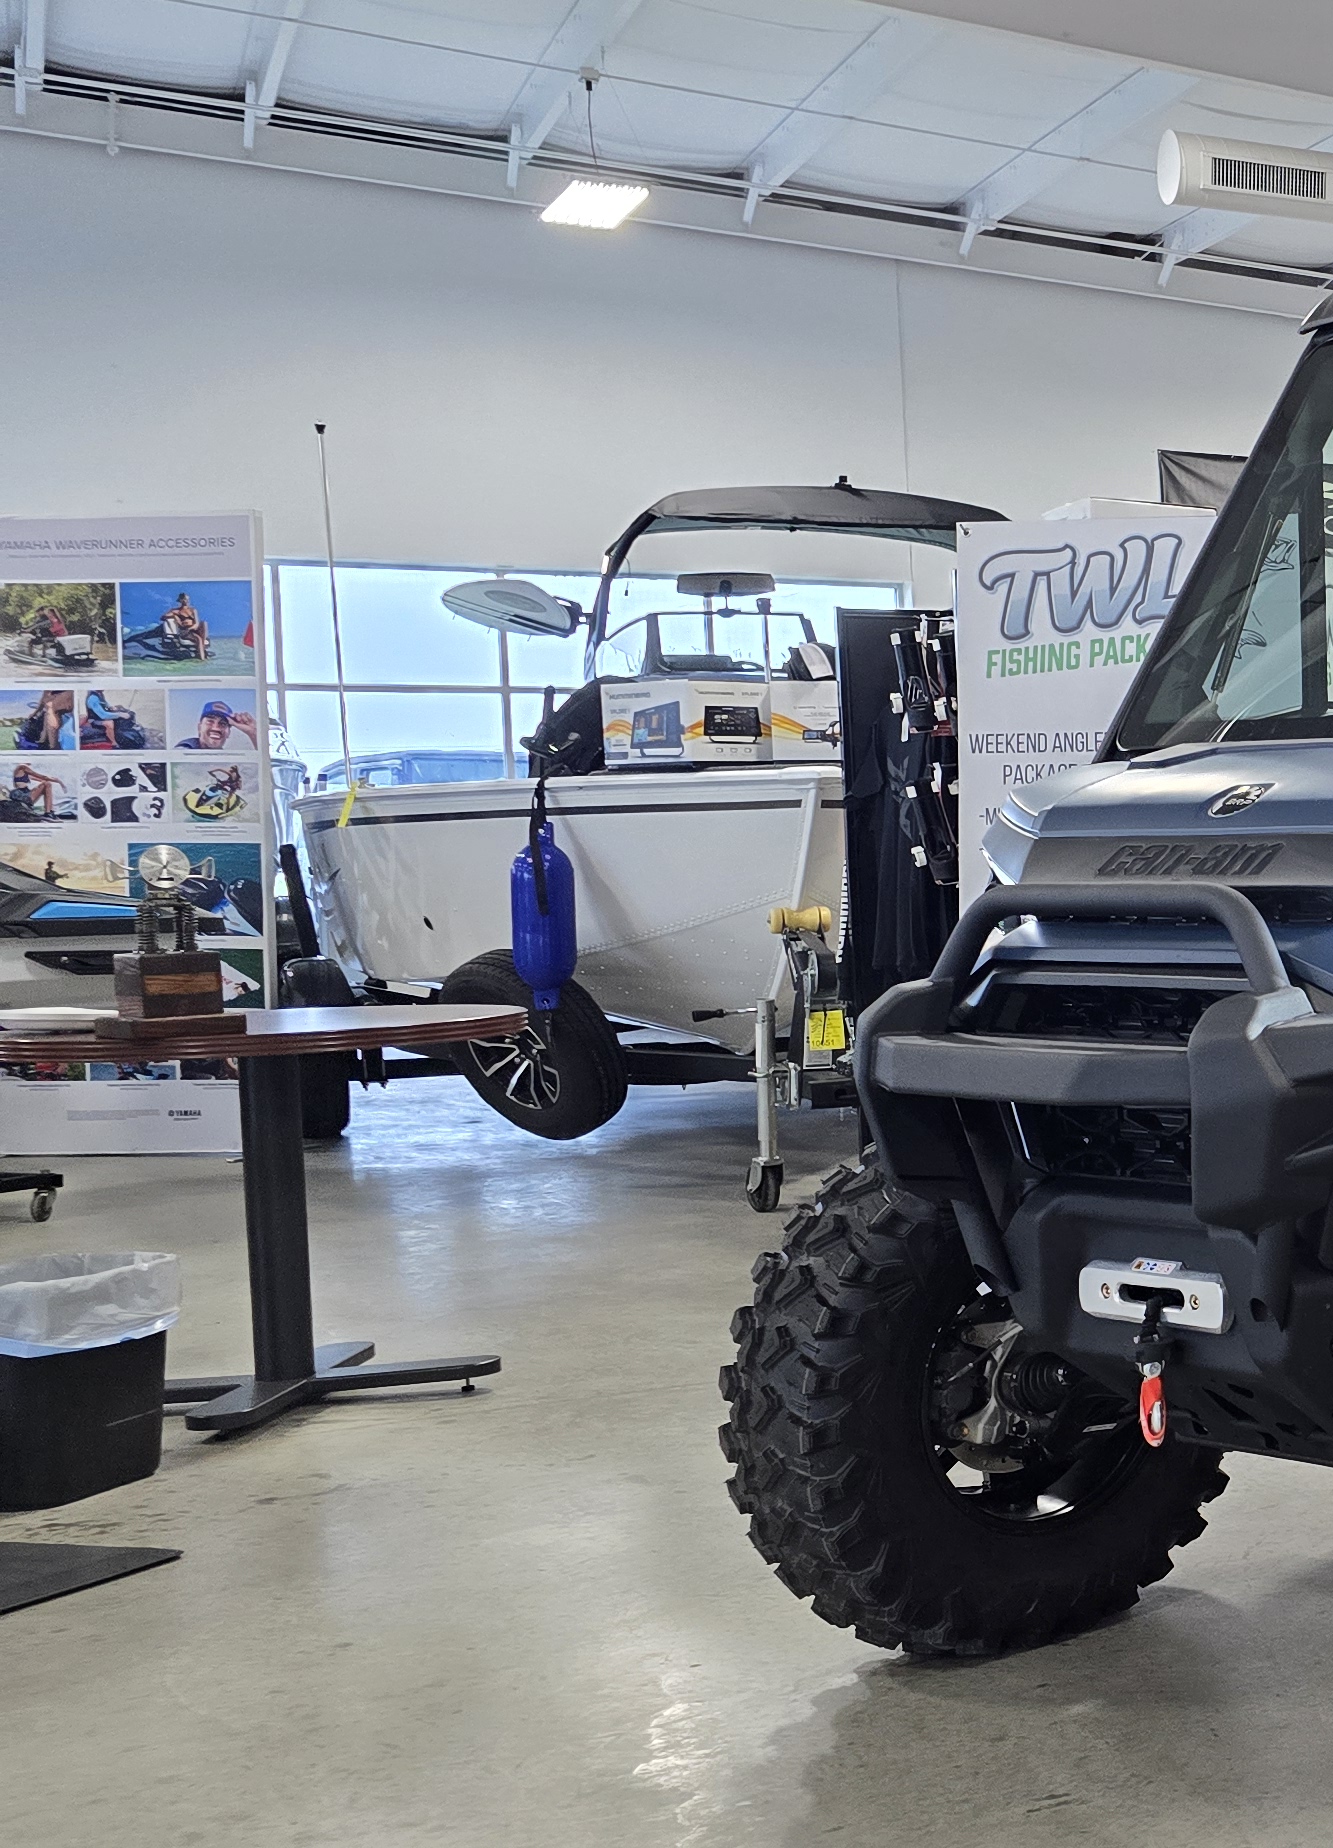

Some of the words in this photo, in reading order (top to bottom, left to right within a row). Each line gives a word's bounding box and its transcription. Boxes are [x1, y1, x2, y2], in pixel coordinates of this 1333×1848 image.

[54, 538, 145, 551] WAVERUNNER
[149, 537, 236, 549] ACCESSORIES
[978, 533, 1183, 641] TWL
[986, 640, 1081, 679] FISHING
[969, 733, 1048, 754] WEEKEND
[1052, 732, 1106, 753] ANGLE
[1096, 842, 1285, 877] can-am
[811, 1040, 835, 1048] 1051
